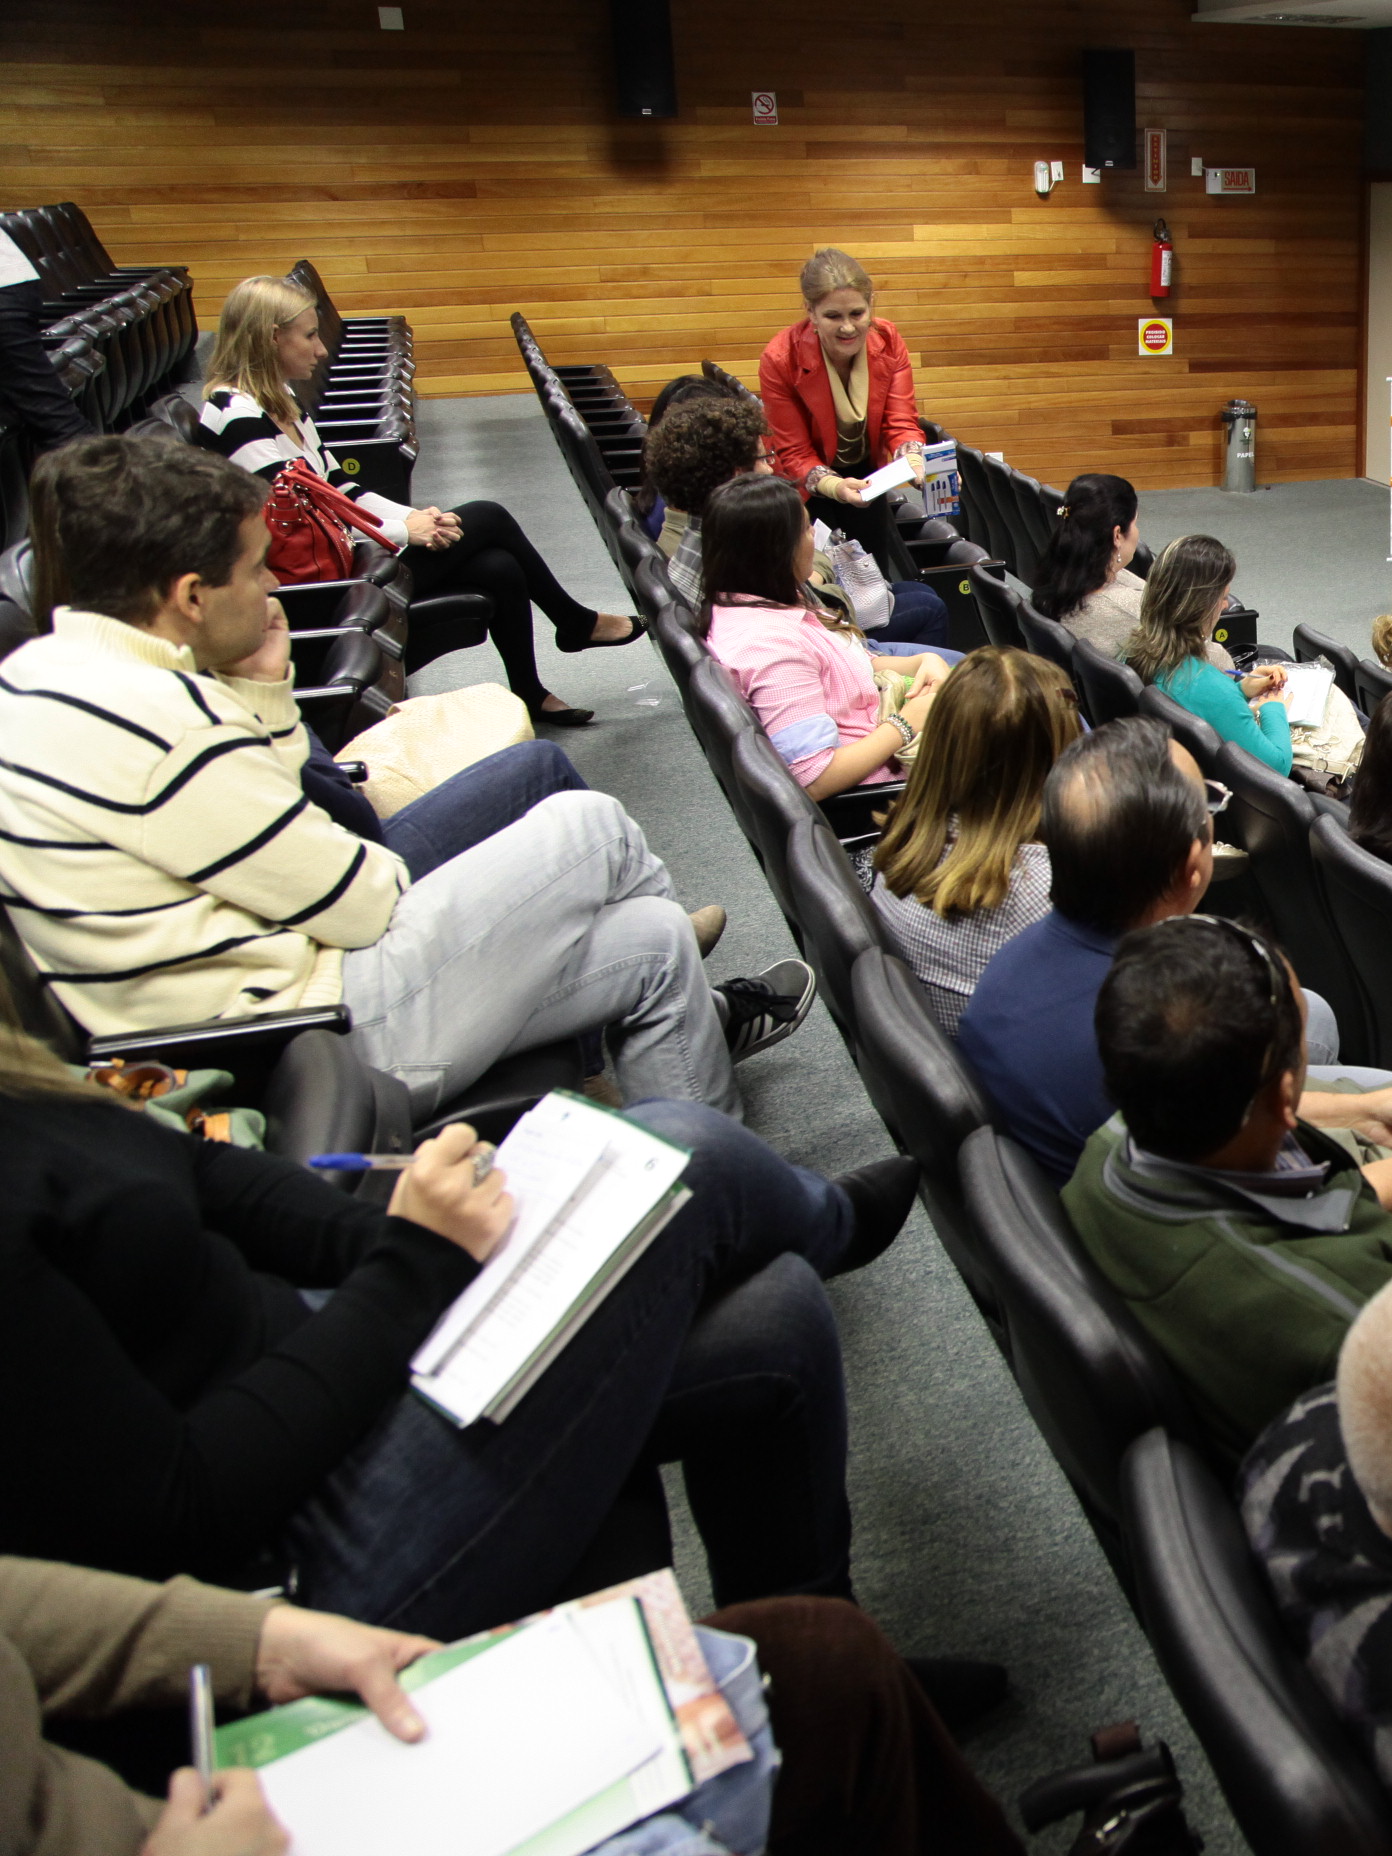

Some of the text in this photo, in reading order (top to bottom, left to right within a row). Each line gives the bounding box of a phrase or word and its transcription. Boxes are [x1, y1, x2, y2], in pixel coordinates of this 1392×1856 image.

[1236, 451, 1255, 459] PAPEL
[348, 462, 356, 471] D
[963, 583, 970, 592] B
